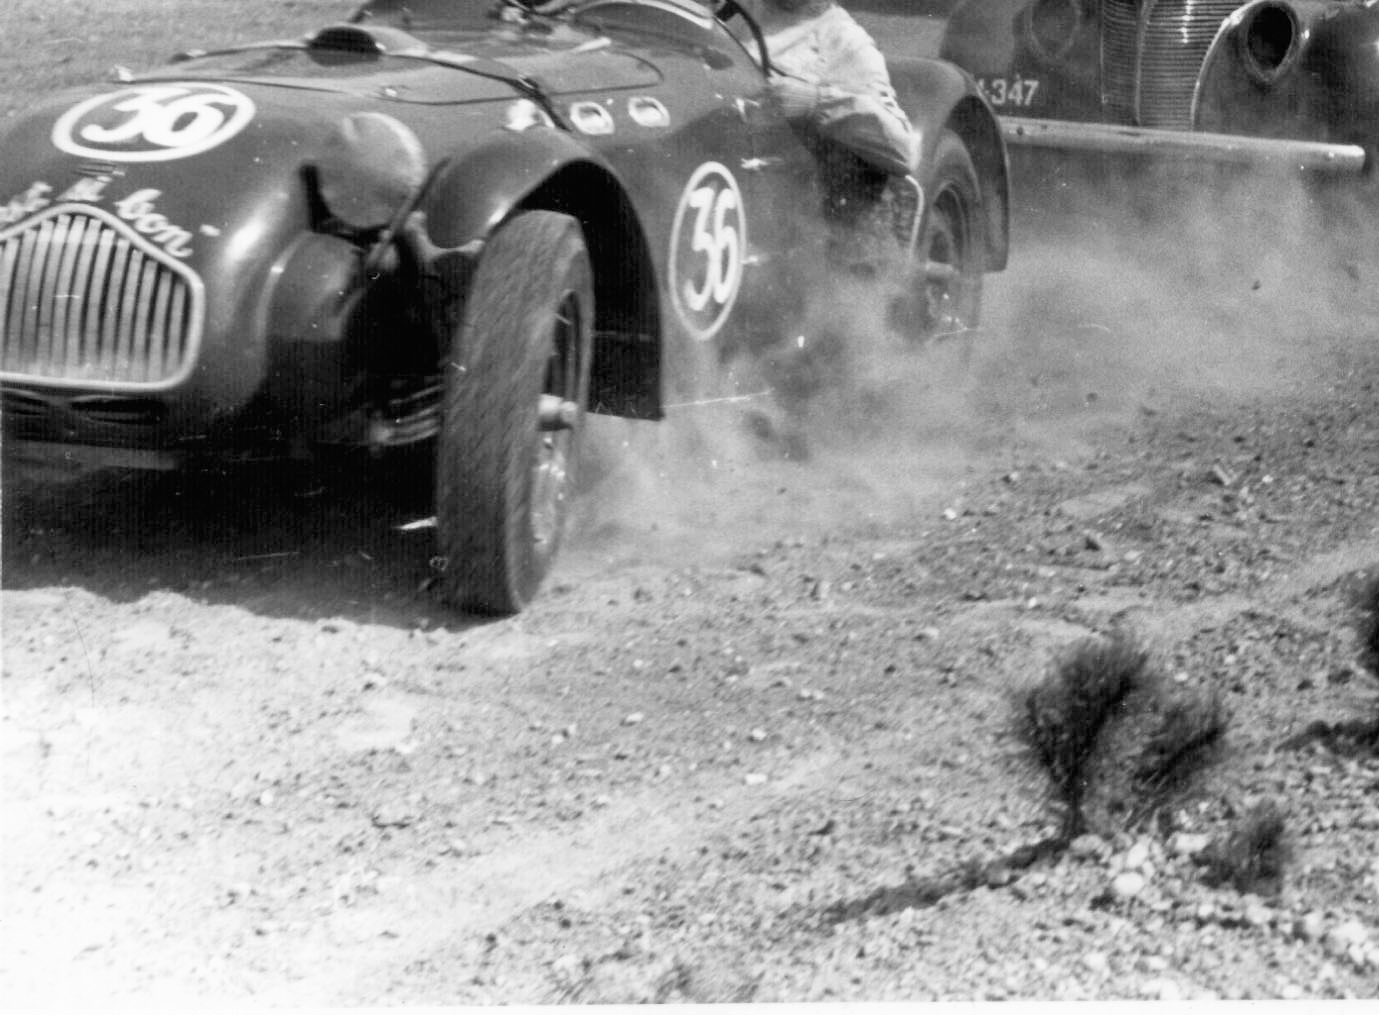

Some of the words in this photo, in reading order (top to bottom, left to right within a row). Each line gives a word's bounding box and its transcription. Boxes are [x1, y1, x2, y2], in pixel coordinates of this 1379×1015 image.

[80, 88, 240, 148] 36
[114, 188, 194, 257] bon
[683, 187, 737, 311] 36
